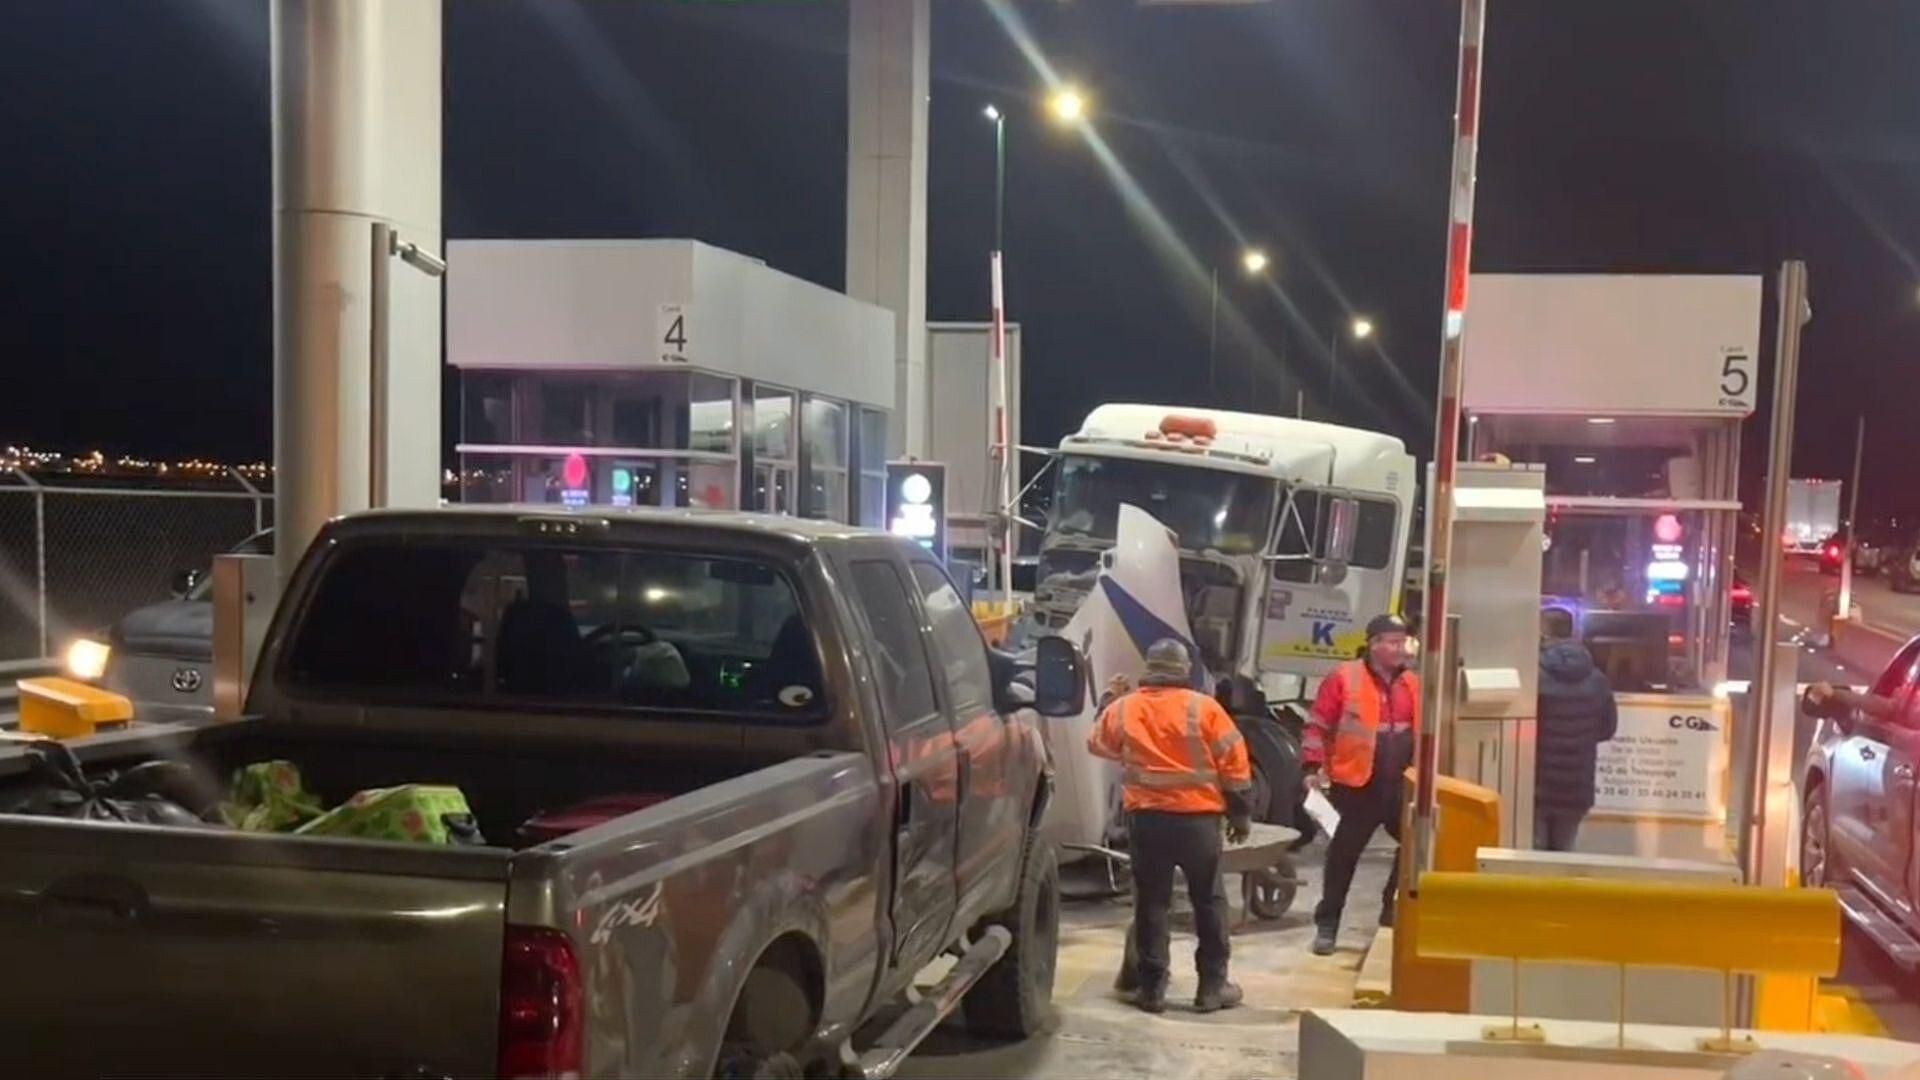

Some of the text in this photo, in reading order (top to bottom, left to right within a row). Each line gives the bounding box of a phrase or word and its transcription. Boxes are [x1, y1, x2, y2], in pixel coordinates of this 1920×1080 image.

[664, 314, 687, 352] 4
[1721, 355, 1748, 396] 5
[1312, 621, 1336, 646] K
